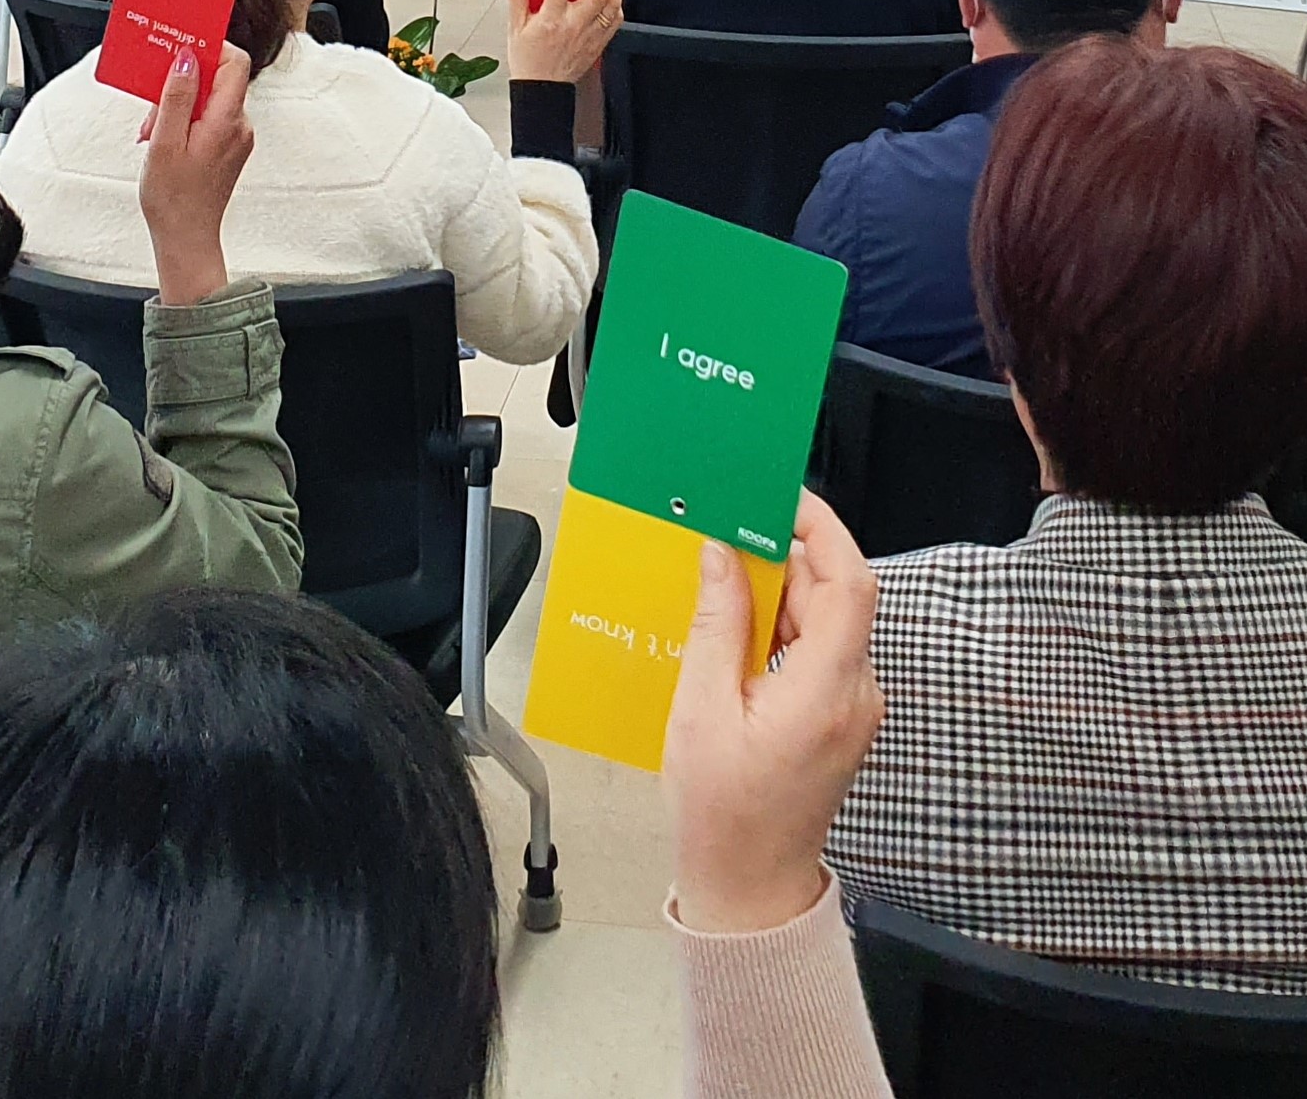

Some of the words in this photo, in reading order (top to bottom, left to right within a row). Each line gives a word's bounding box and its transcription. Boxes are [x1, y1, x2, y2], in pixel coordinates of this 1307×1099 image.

[126, 10, 149, 28] idea
[152, 19, 196, 46] different
[147, 34, 173, 53] have
[659, 332, 669, 359] I
[676, 344, 756, 391] agree
[570, 610, 635, 651] know
[647, 632, 683, 661] n't
